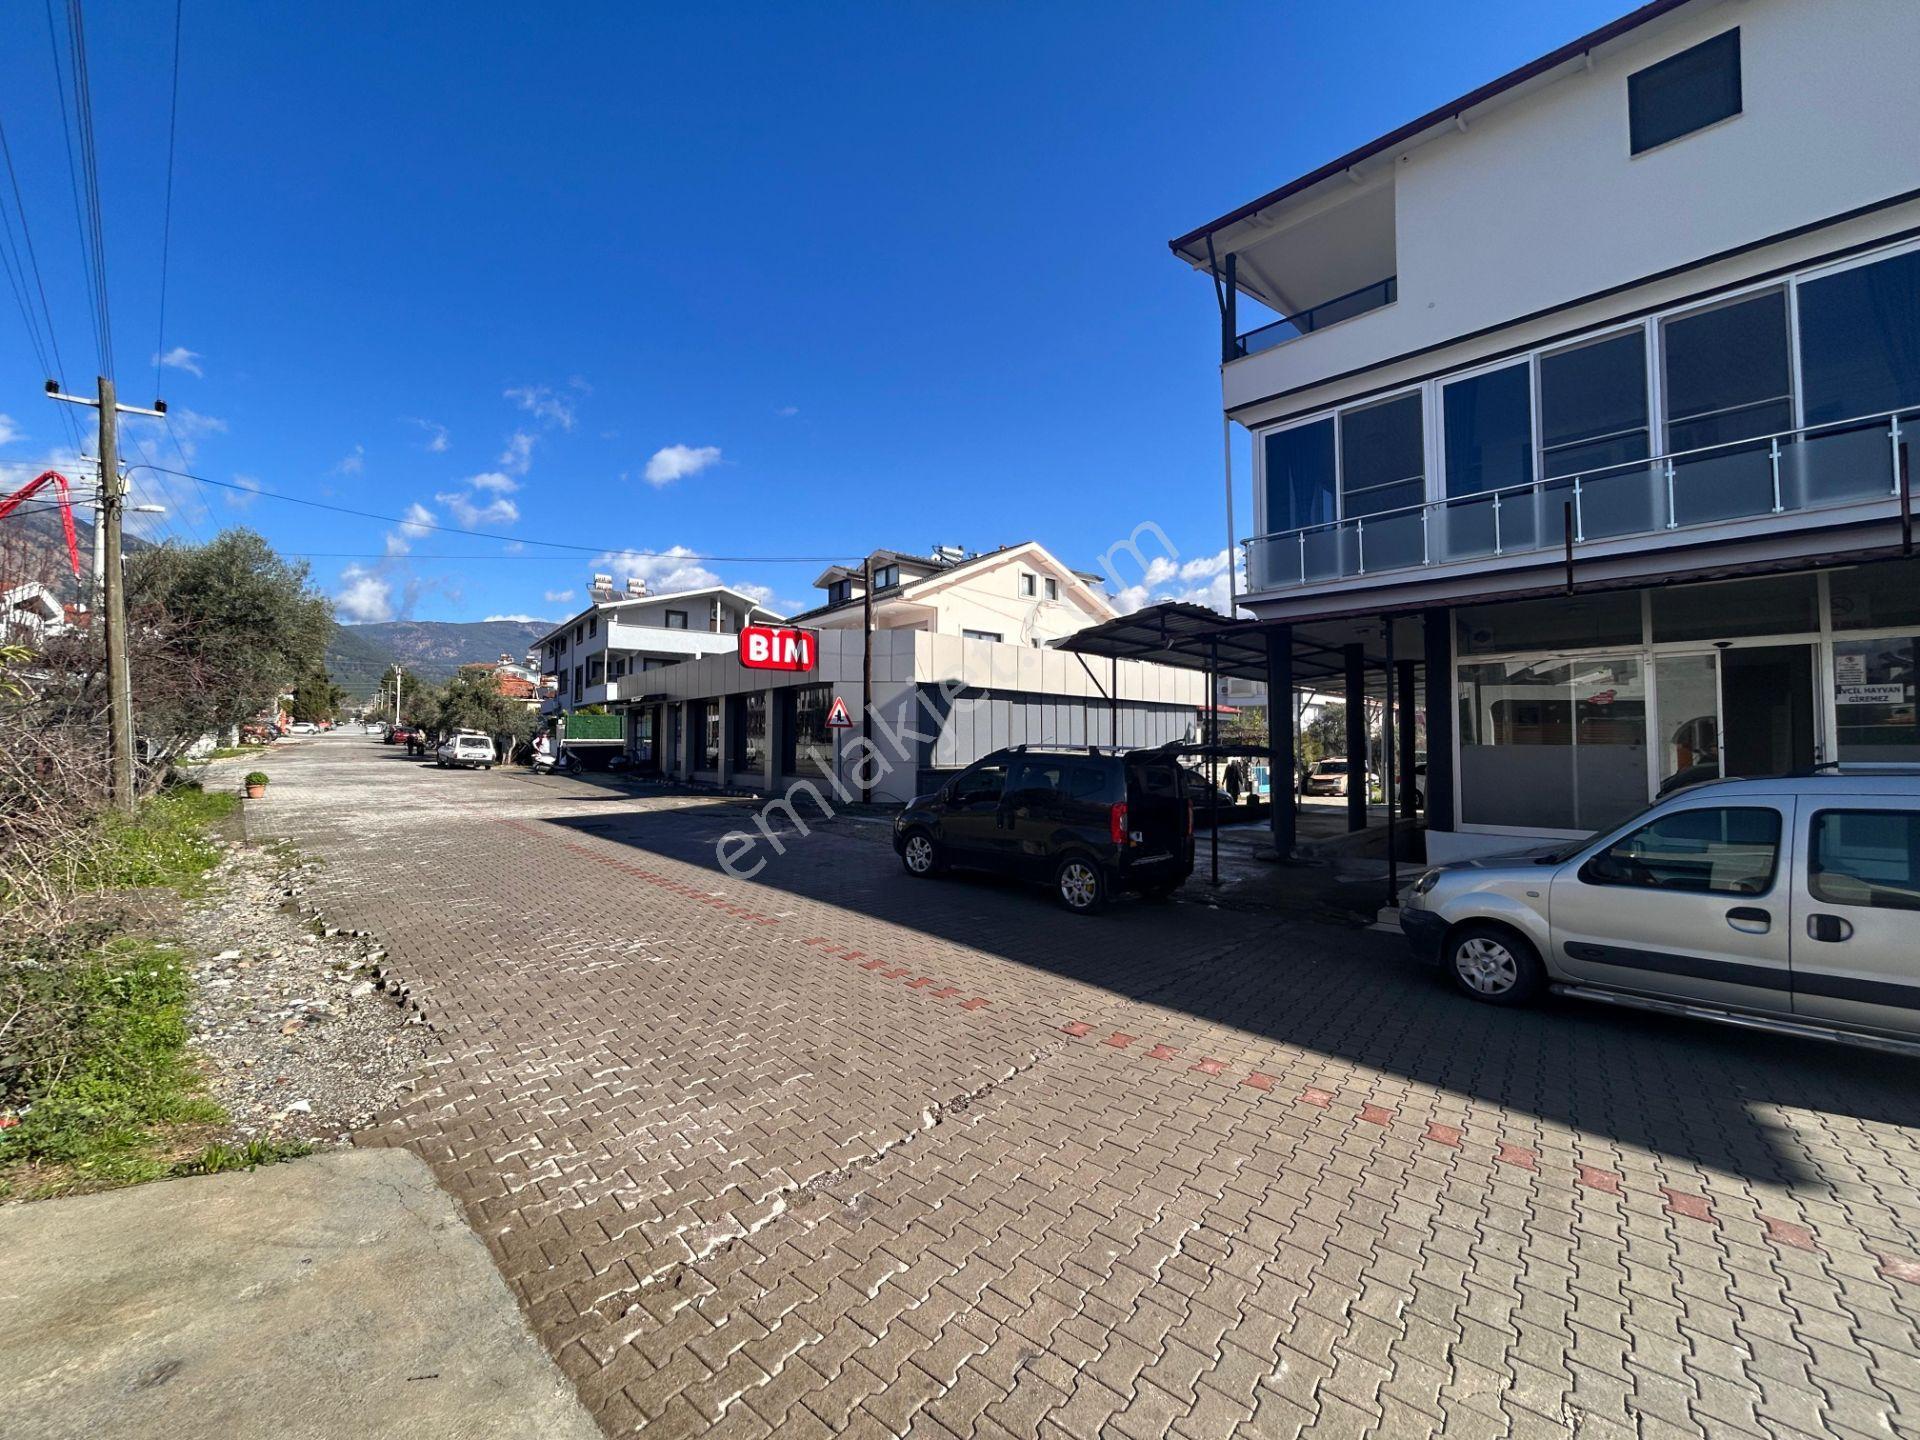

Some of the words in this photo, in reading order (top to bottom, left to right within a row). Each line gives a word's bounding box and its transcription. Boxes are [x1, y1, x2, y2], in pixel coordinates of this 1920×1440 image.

[748, 629, 809, 665] BİM
[1864, 686, 1901, 694] HAYVAN
[1848, 694, 1889, 703] GİREMEZ
